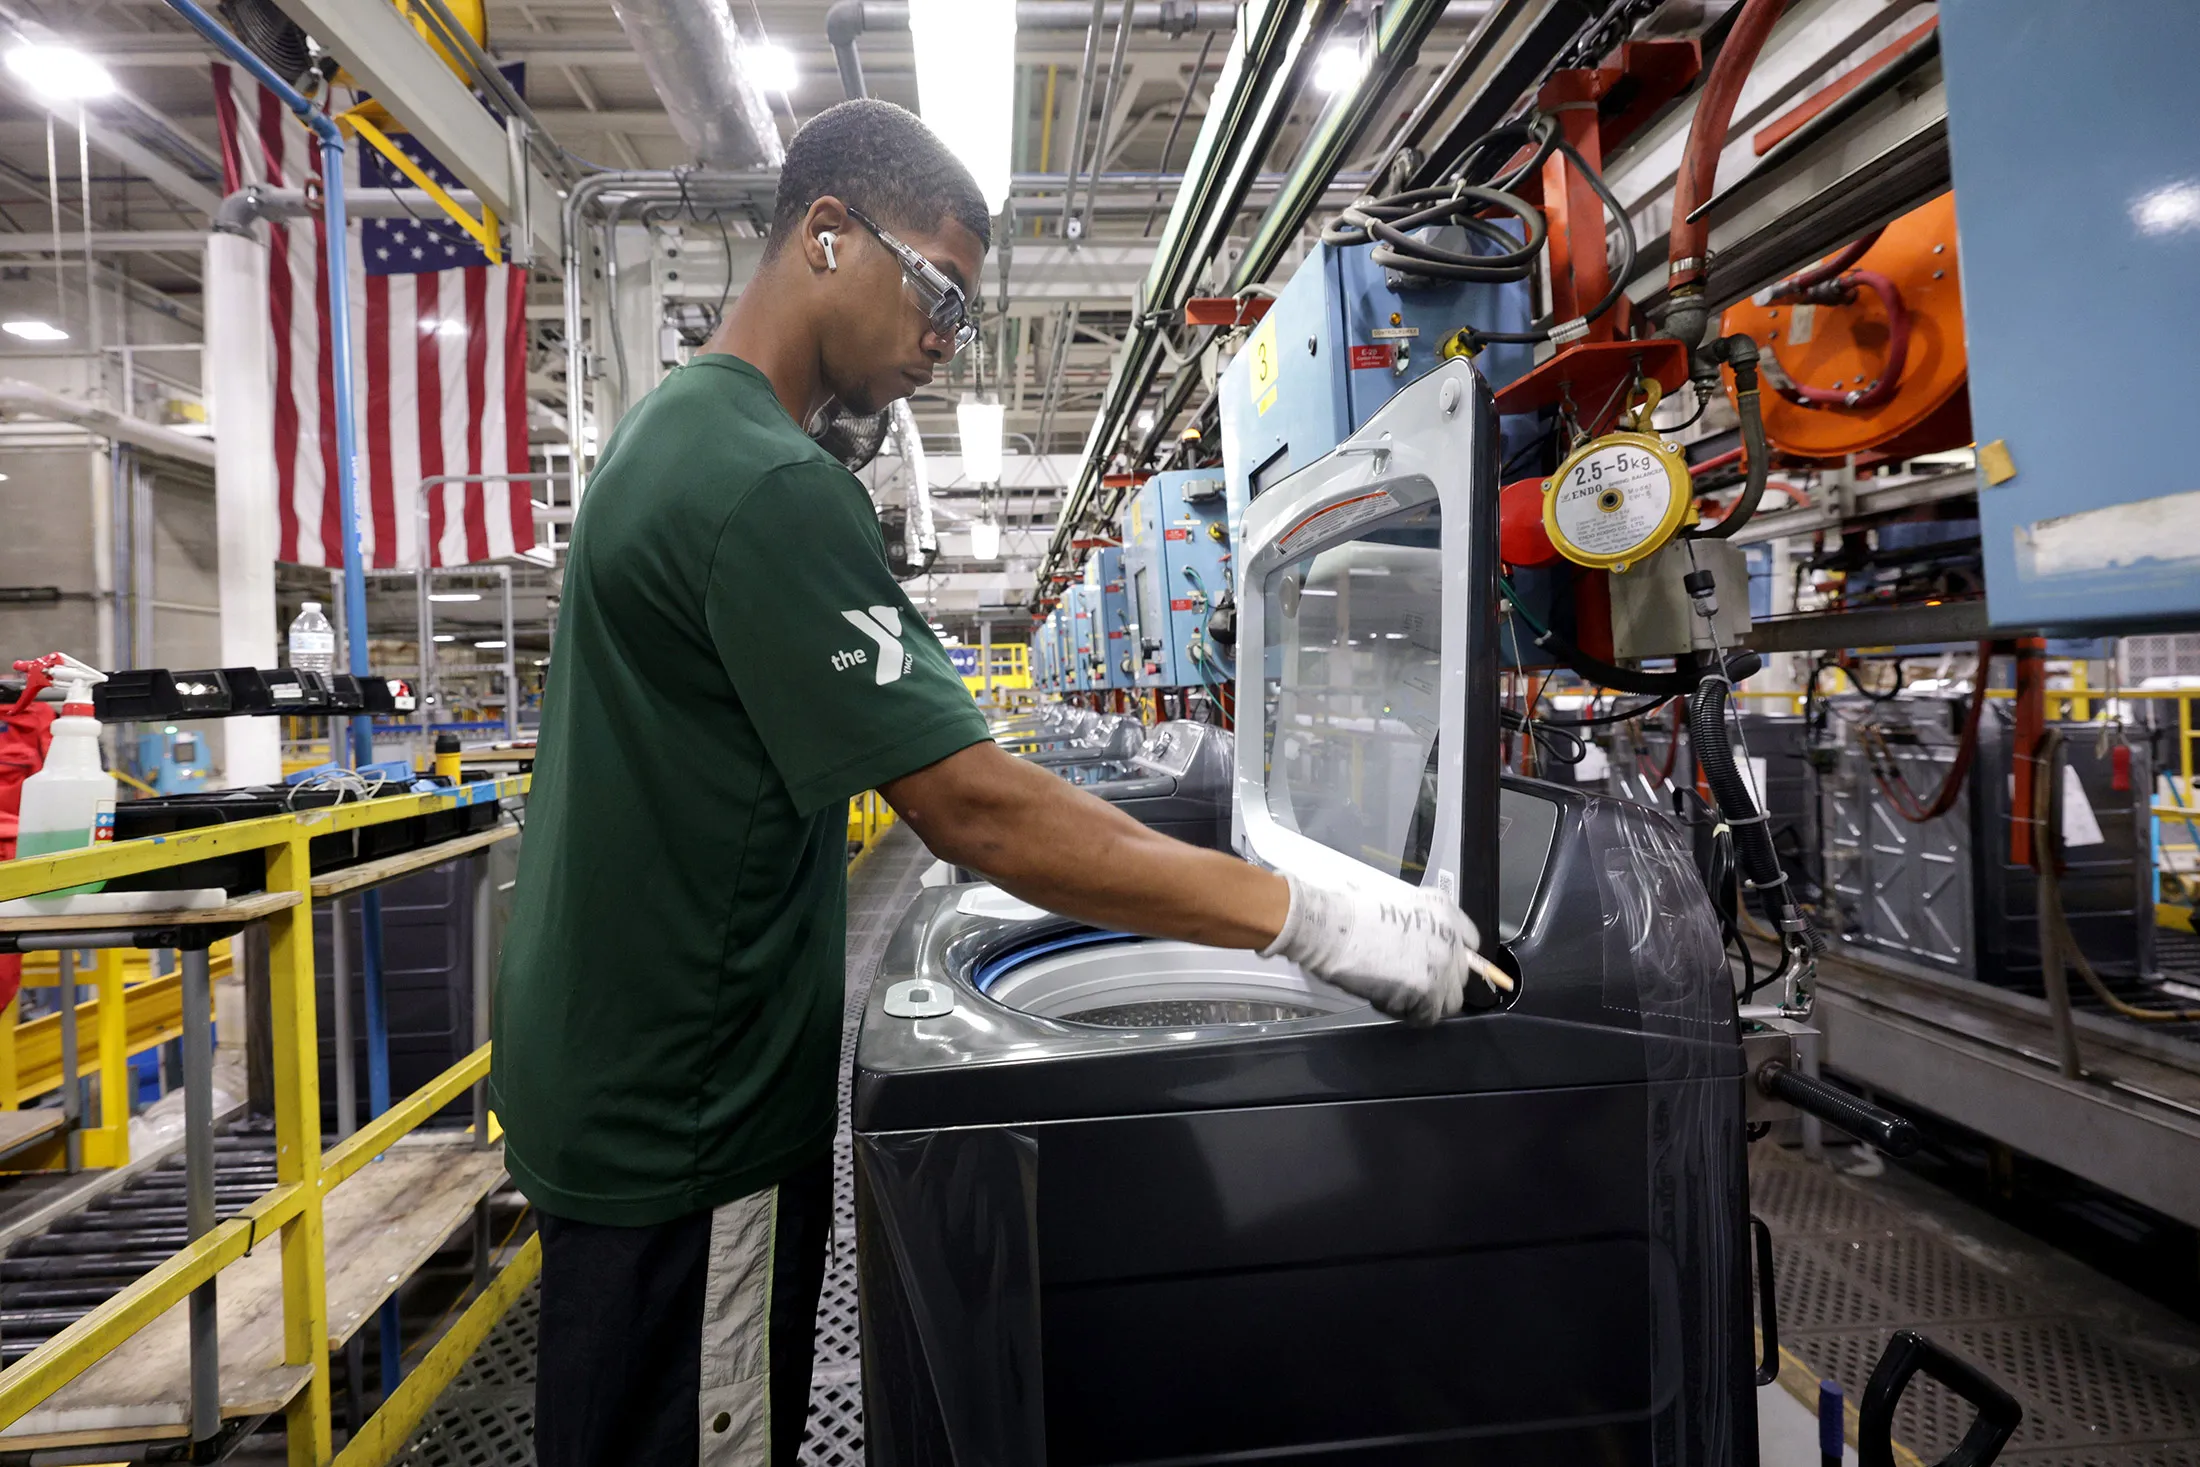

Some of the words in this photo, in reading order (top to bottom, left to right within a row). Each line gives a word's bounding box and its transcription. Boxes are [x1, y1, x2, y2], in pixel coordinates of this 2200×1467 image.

[1258, 342, 1268, 382] 3
[831, 648, 867, 672] the
[903, 653, 913, 675] YMCA
